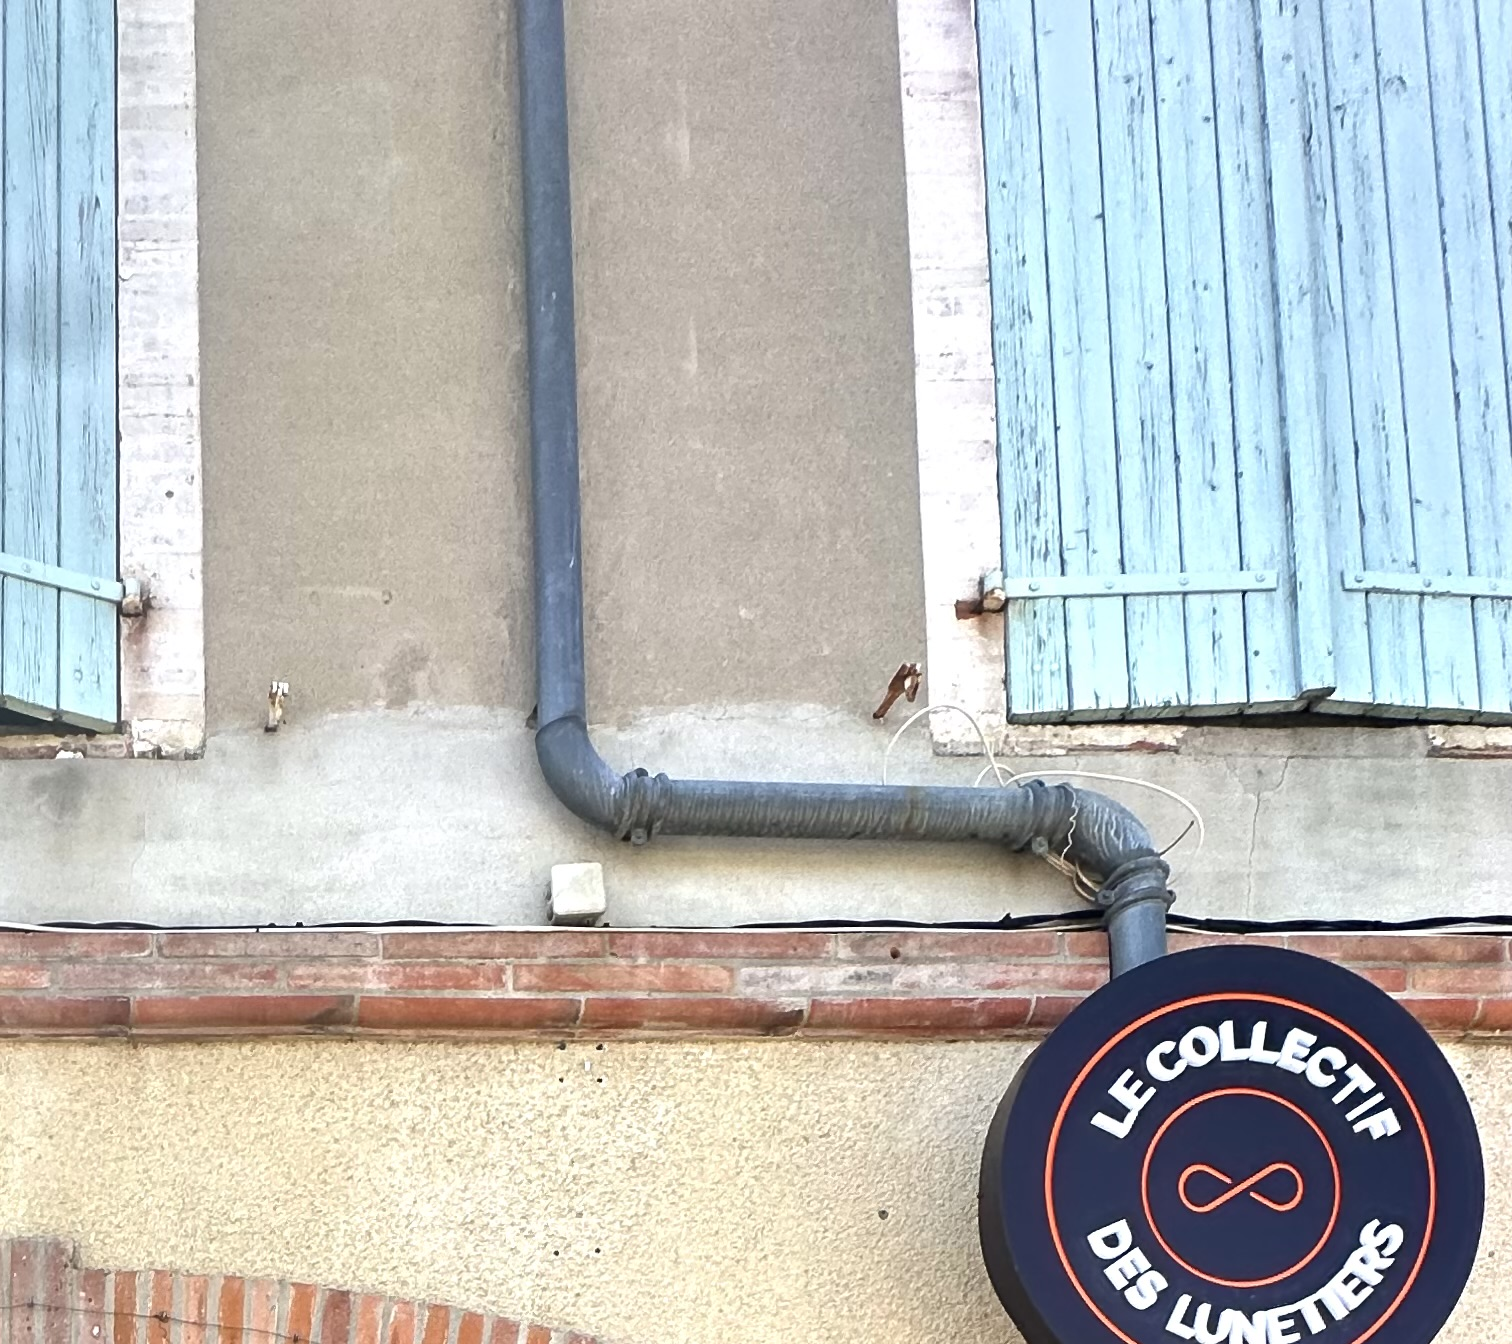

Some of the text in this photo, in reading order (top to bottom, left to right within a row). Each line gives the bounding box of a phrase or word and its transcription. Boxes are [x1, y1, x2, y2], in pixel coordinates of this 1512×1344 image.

[1090, 1020, 1402, 1140] LE COLLECTIF
[1087, 1218, 1169, 1311] DES
